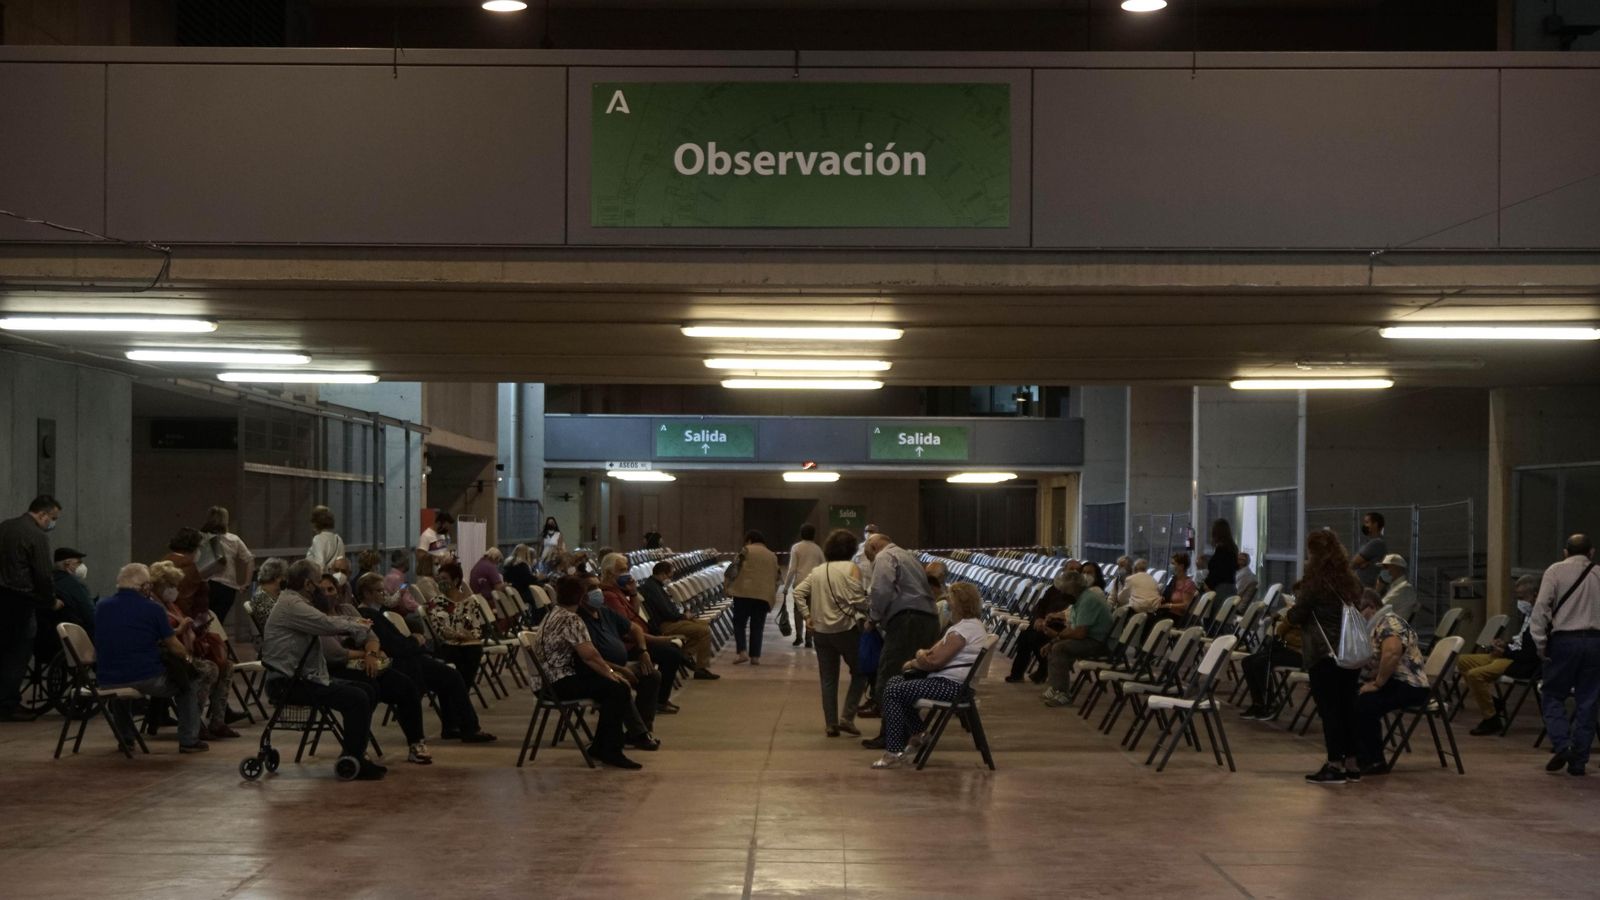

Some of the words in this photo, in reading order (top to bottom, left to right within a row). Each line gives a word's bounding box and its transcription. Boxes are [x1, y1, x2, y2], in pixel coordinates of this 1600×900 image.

[673, 141, 926, 176] Observación
[684, 429, 728, 442] Salida
[898, 432, 941, 445] Salida
[839, 508, 857, 519] Salida
